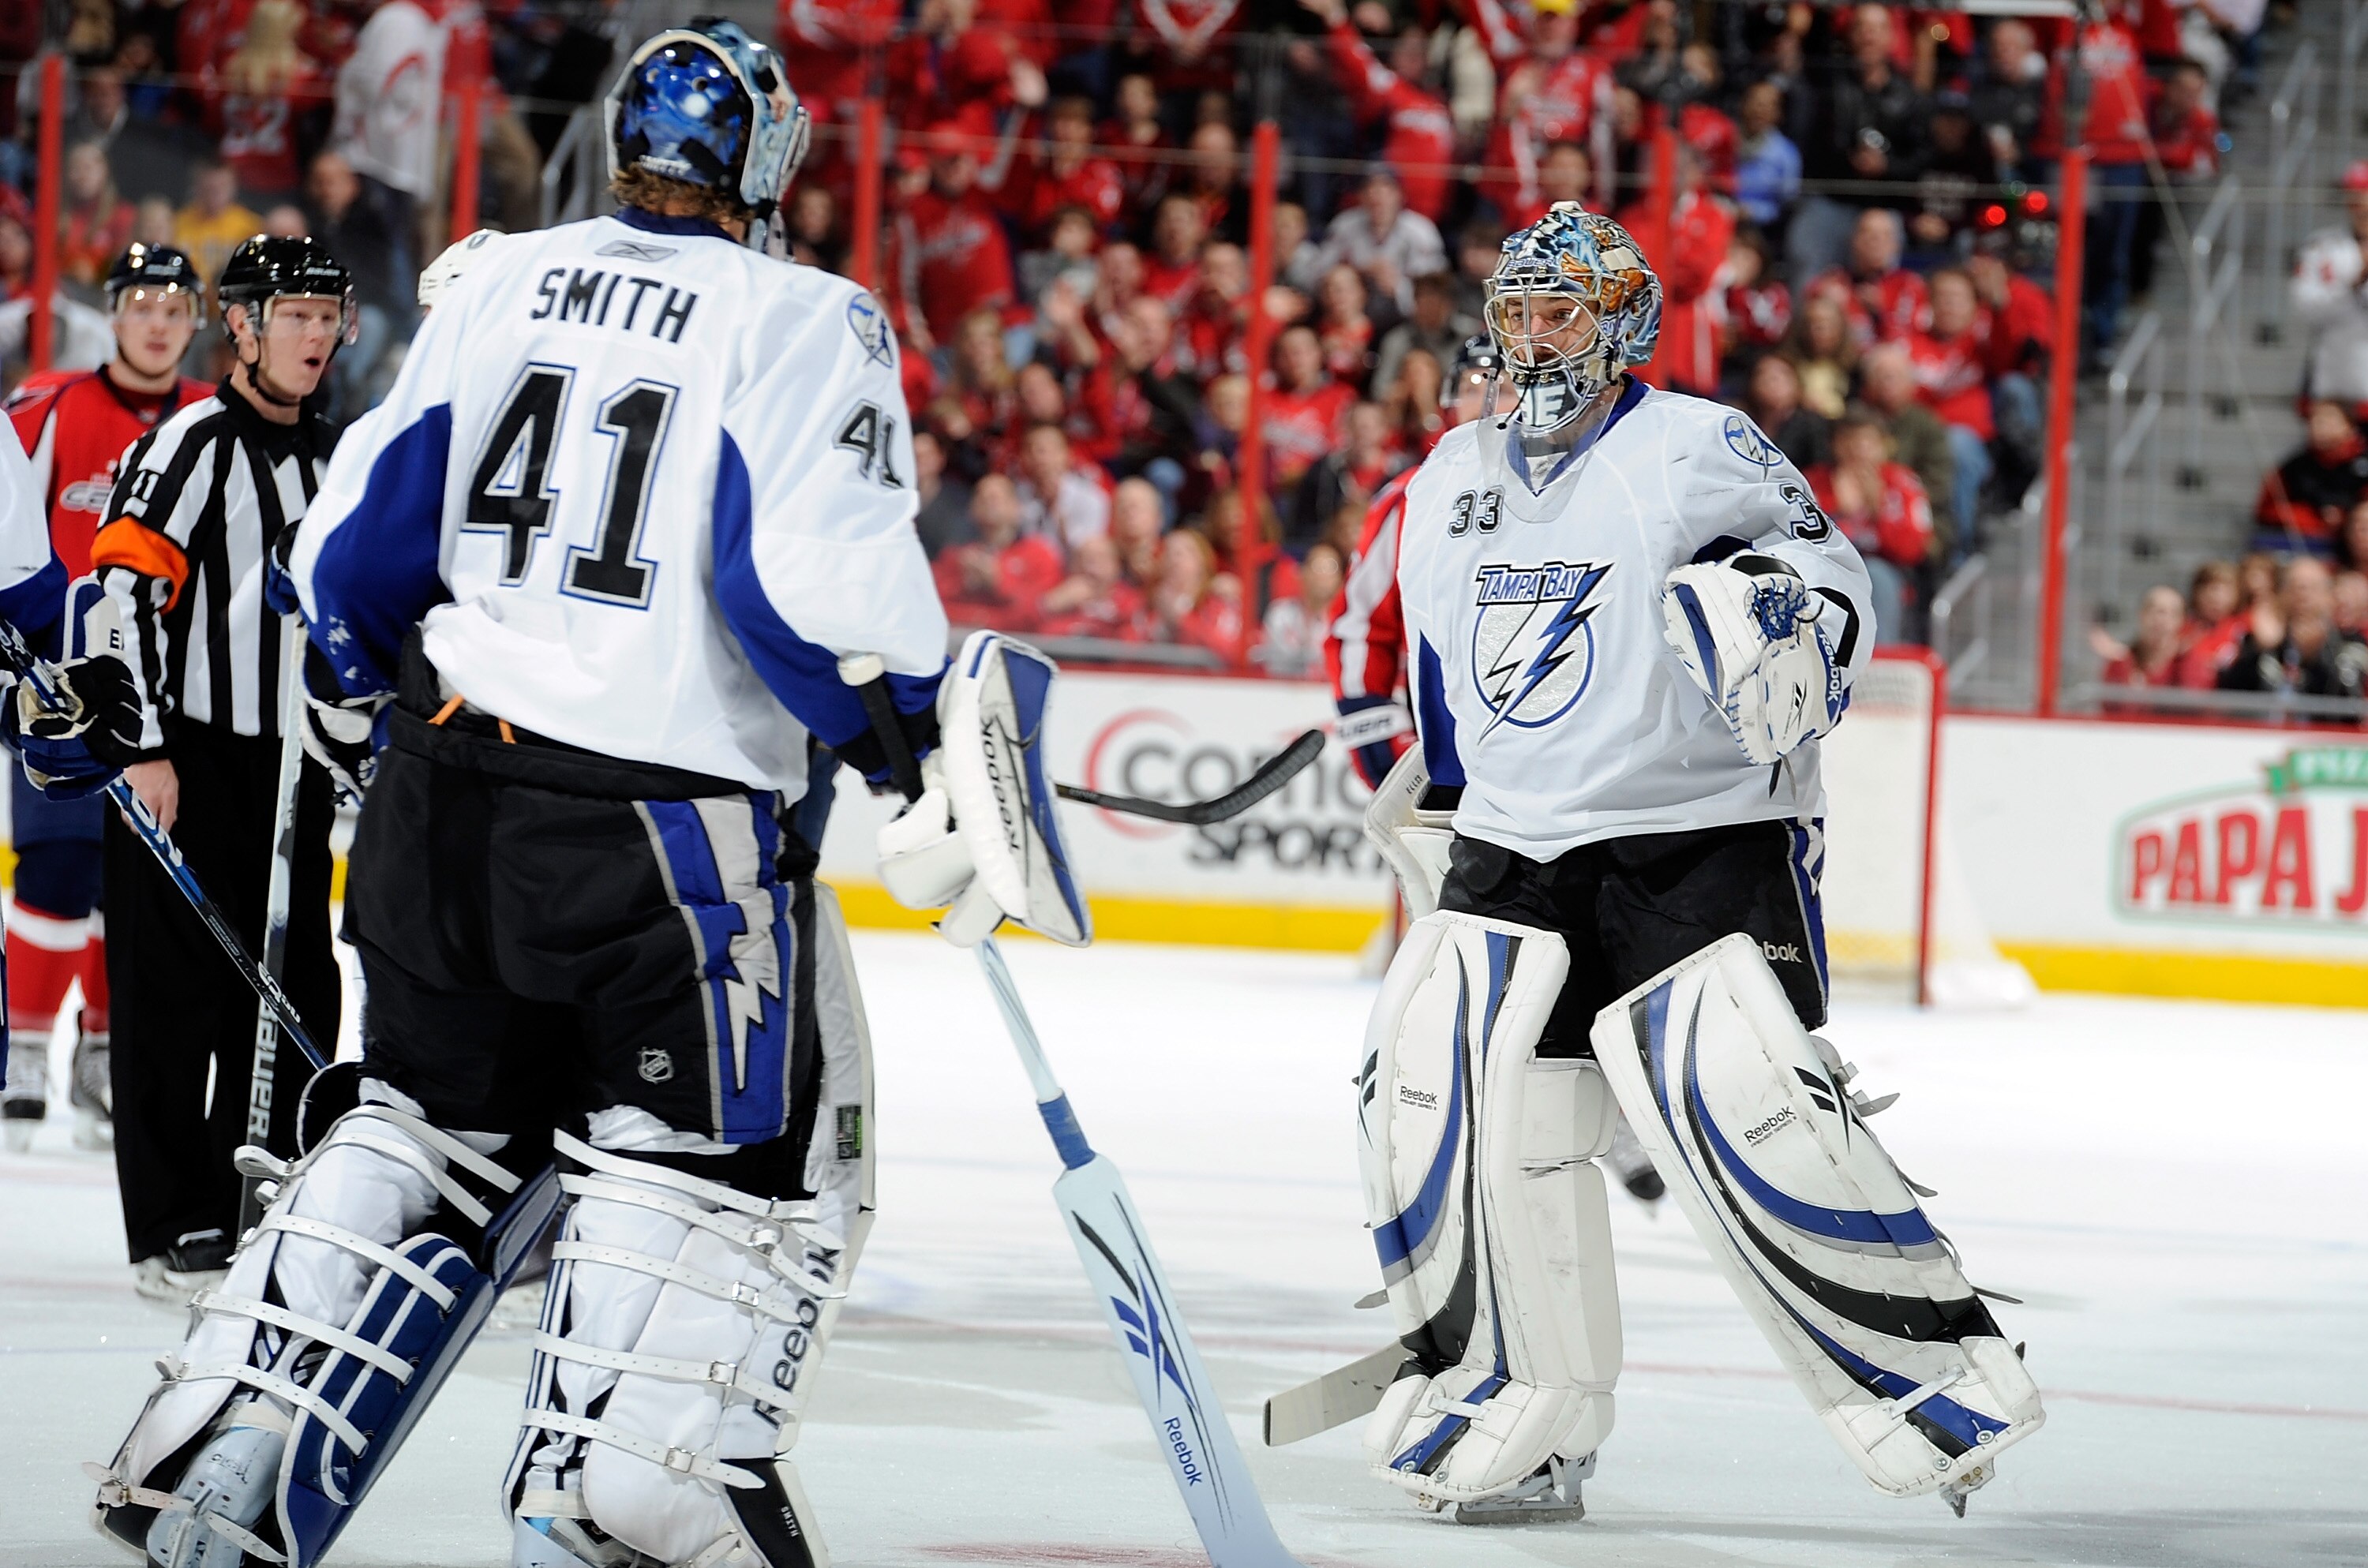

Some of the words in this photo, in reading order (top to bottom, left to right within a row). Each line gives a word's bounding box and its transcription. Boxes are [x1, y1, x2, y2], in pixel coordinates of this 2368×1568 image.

[530, 268, 699, 343] SMITH
[832, 399, 904, 489] 41
[131, 471, 159, 501] 41
[460, 357, 680, 612] 41
[1448, 485, 1506, 538] 33
[1779, 483, 1833, 544] 3
[1479, 567, 1542, 602] TAMPA
[1541, 563, 1585, 598] BAY
[1188, 821, 1383, 870] SPOR
[2133, 808, 2314, 909] PAPA
[1762, 941, 1803, 964] bok
[1399, 1085, 1438, 1105] Reebok
[1744, 1106, 1796, 1143] Reebok
[1163, 1416, 1202, 1488] Reebok
